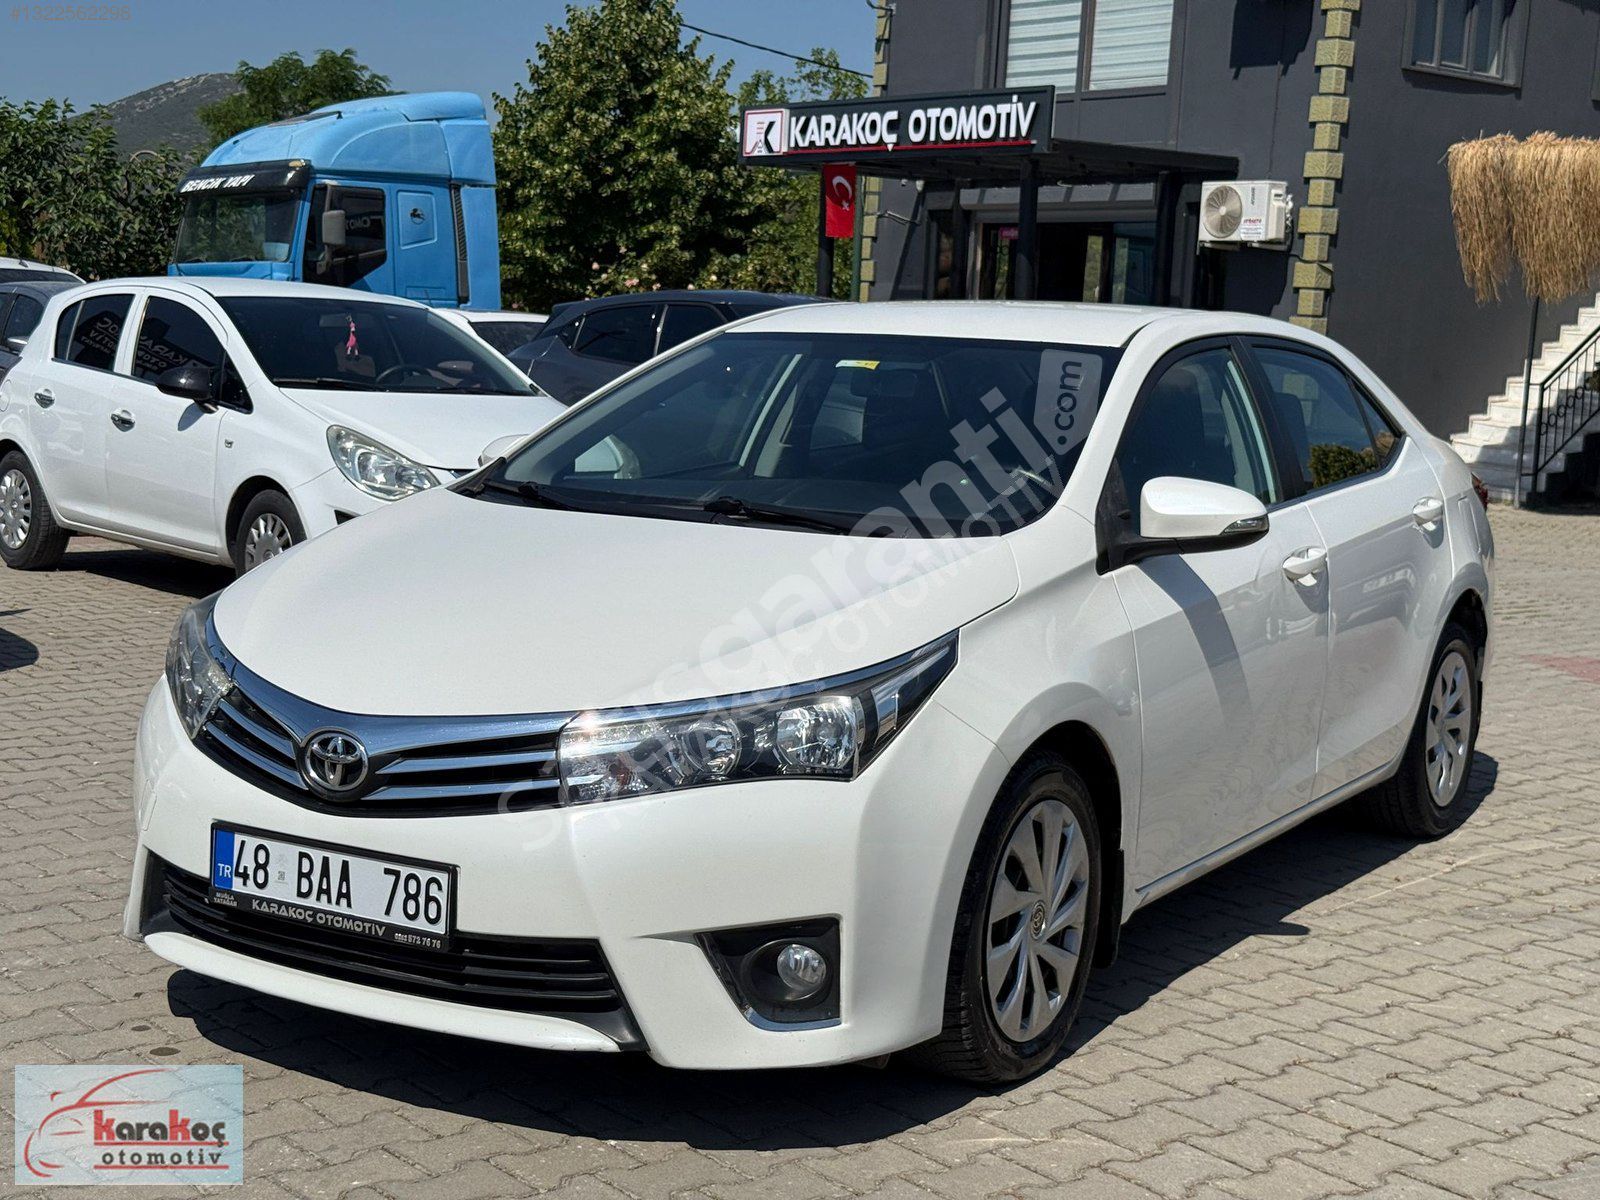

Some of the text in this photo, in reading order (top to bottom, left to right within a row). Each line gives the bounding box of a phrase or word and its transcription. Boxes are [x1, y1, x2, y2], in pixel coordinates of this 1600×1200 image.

[789, 94, 1037, 152] KARAKOÇ OTOMOTİV
[217, 862, 232, 878] TR
[233, 839, 443, 925] 48 BAA 786
[251, 899, 386, 937] KARAKOÇ OTOMOTİV
[421, 937, 431, 947] 76
[431, 939, 442, 949] 76
